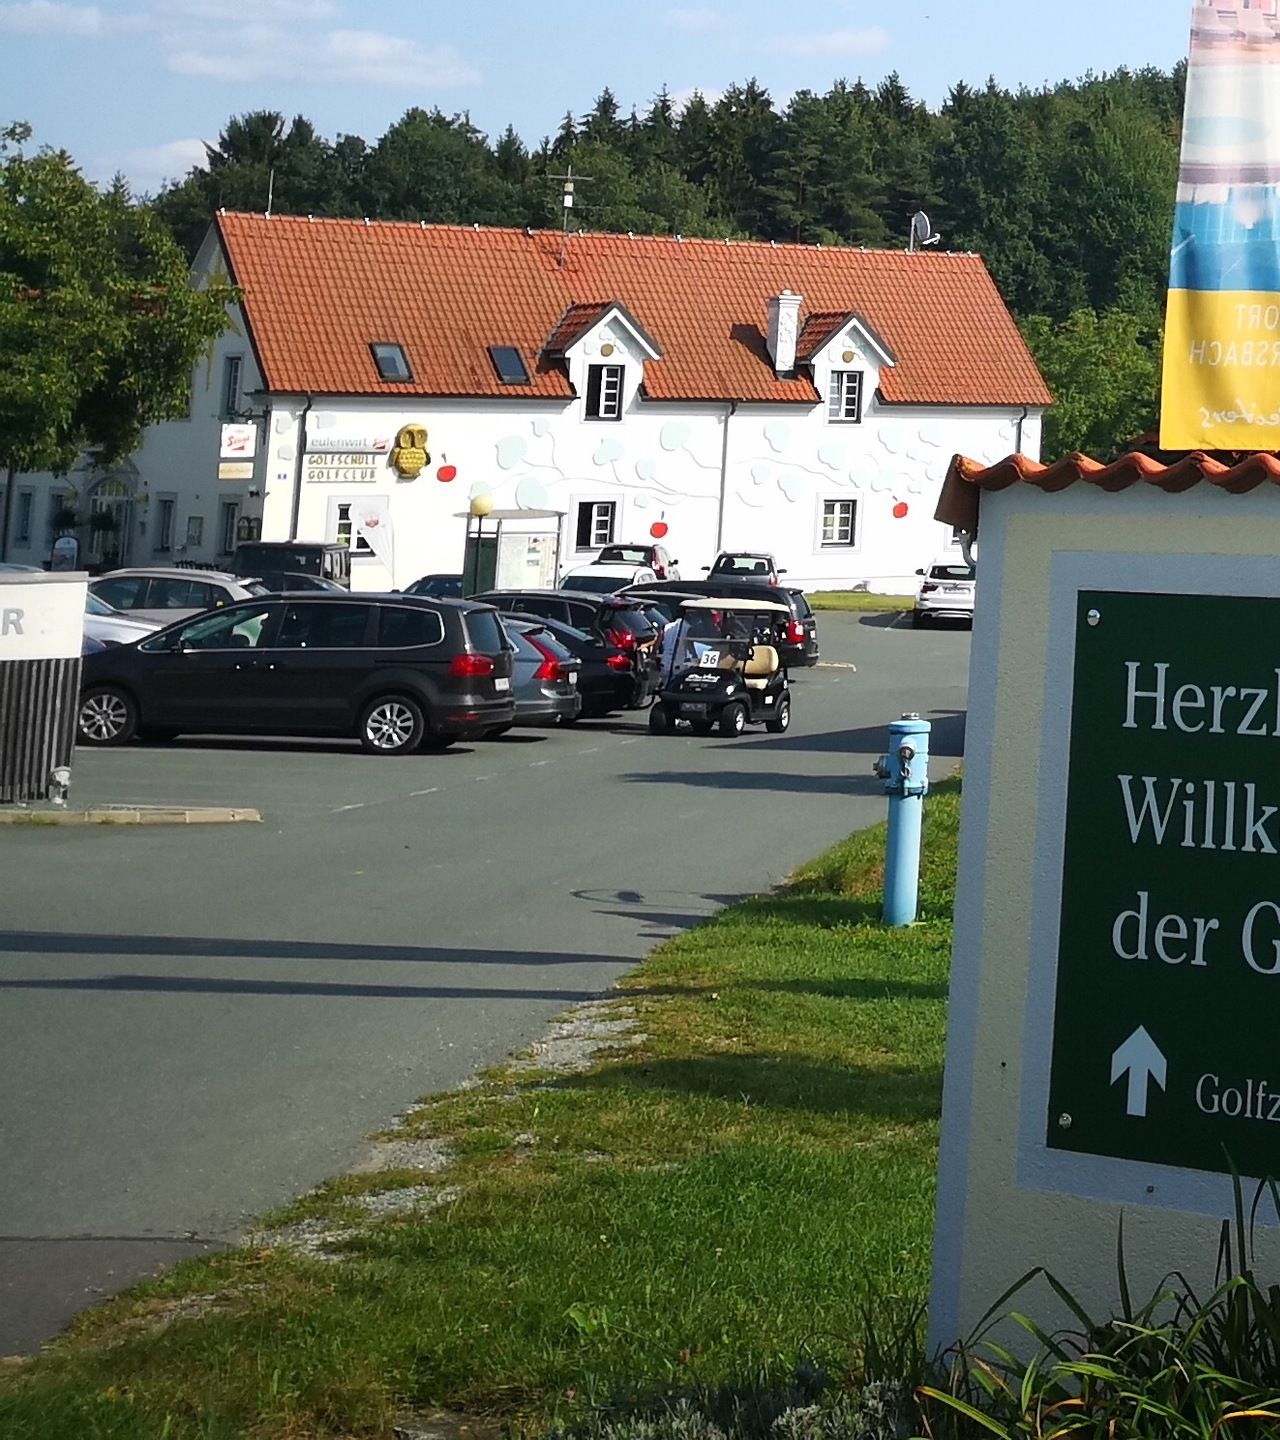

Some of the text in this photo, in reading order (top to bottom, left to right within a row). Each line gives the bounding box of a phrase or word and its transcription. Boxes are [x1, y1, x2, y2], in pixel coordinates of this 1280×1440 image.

[308, 469, 377, 481] GOLFCLUB
[2, 608, 25, 636] R
[703, 654, 717, 664] 36
[1111, 891, 1221, 967] der
